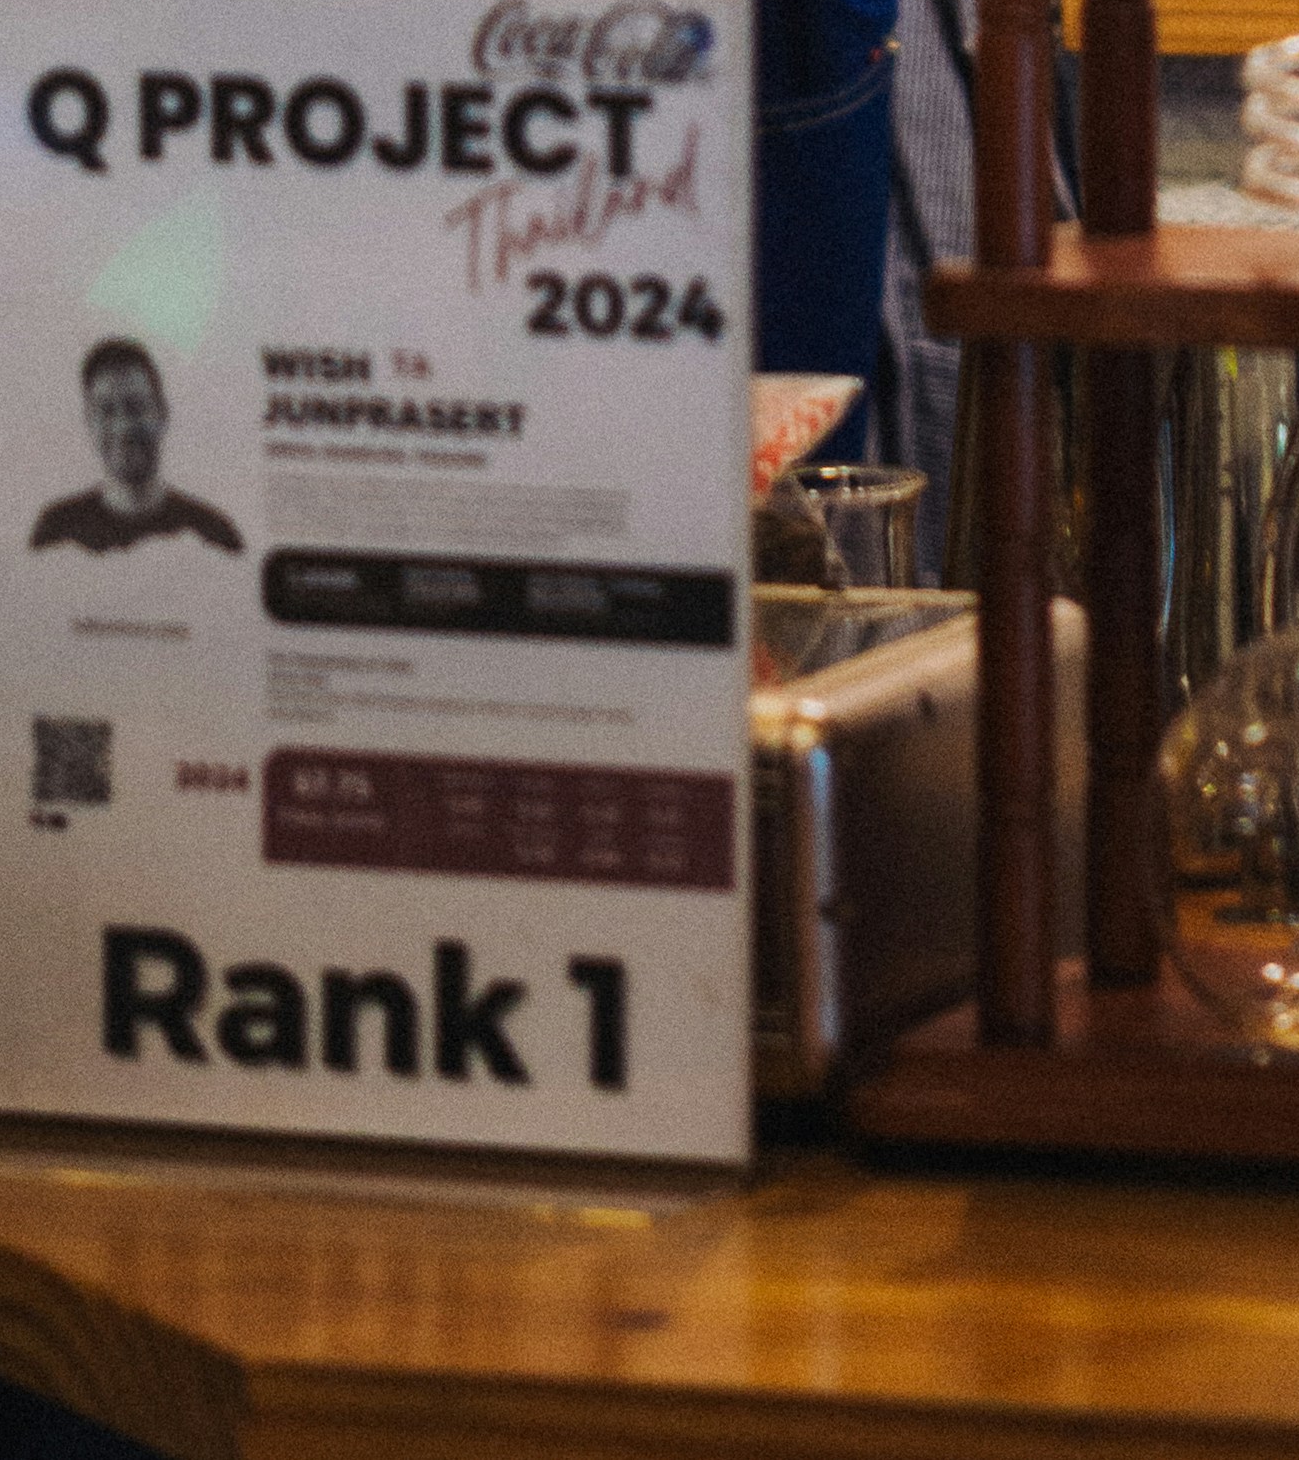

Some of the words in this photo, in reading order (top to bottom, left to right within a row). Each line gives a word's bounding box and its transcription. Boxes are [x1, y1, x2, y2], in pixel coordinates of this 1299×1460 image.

[29, 64, 110, 176] Q
[136, 69, 655, 182] PROJECT
[525, 269, 726, 346] 2024
[261, 345, 370, 388] WISH
[102, 920, 533, 1088] Rank
[566, 954, 631, 1092] 1
